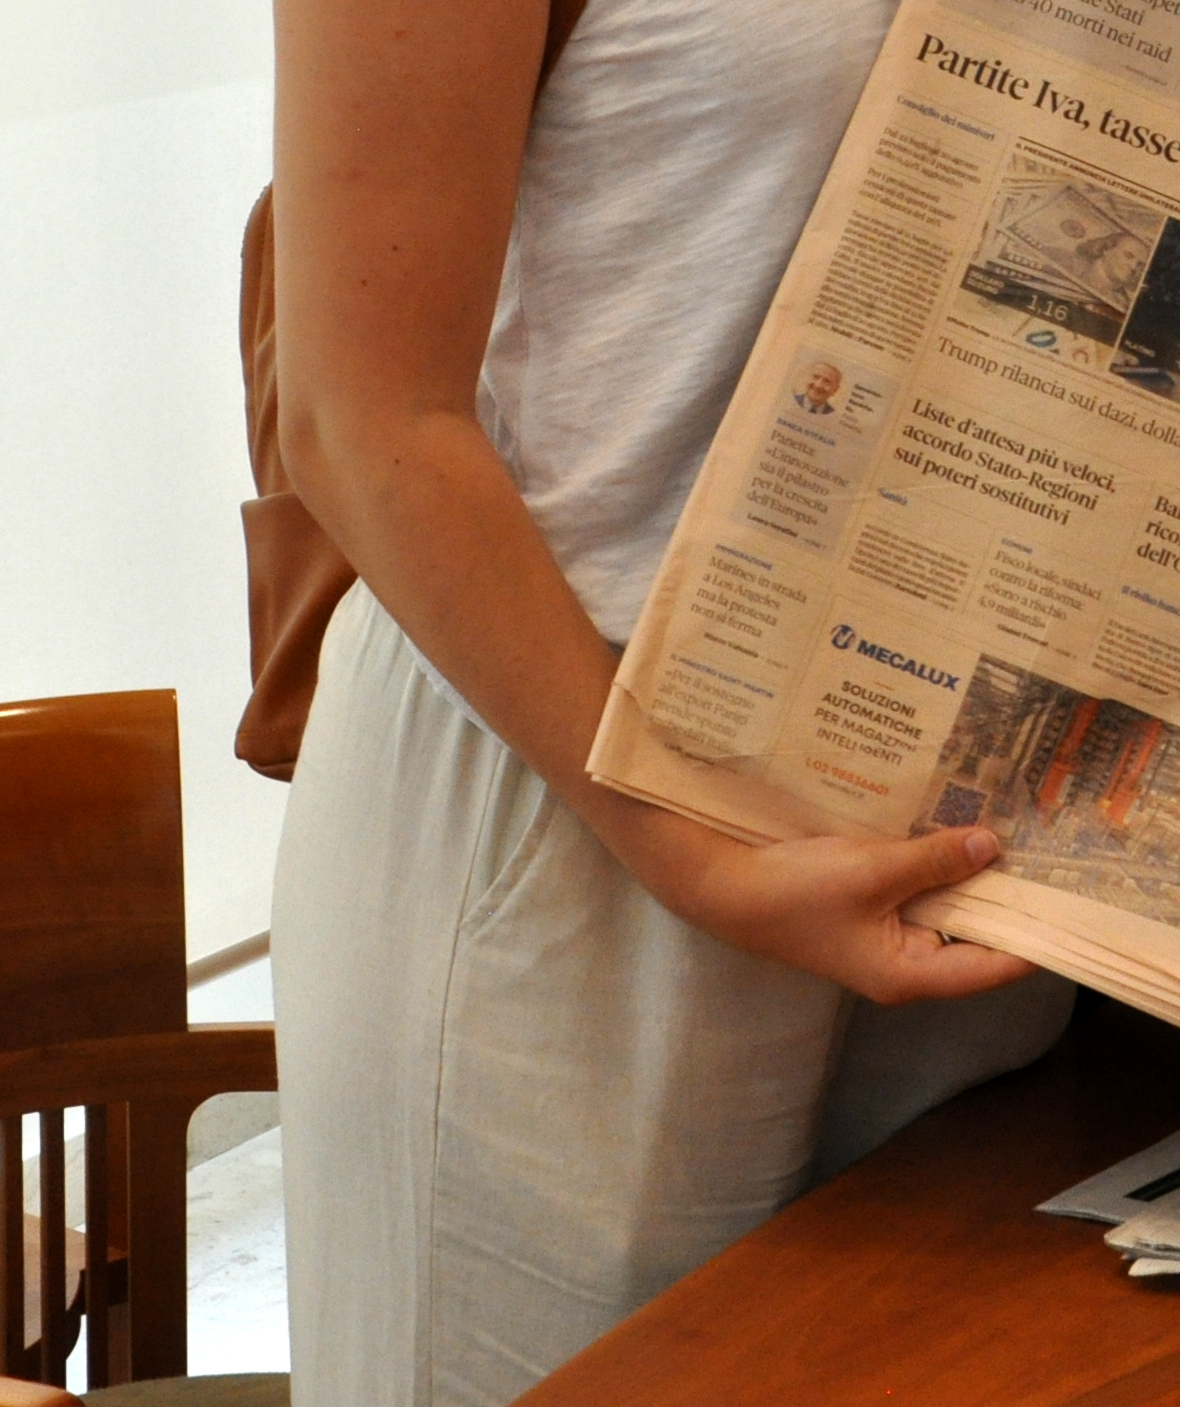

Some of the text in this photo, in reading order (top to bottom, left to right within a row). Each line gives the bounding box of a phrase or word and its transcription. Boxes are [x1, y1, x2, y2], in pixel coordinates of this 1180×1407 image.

[1054, 6, 1106, 35] morti
[1105, 27, 1136, 48] nei
[1135, 39, 1173, 63] raid
[916, 33, 1030, 100] Partite
[1032, 80, 1090, 130] Iva,
[1022, 294, 1068, 321] 1,16
[938, 336, 999, 375] Trump
[1000, 364, 1066, 401] rilancia
[1068, 392, 1098, 412] sui
[1098, 401, 1138, 431] dazi,
[902, 425, 1099, 511] accordo Stato-Regioni
[912, 398, 956, 428] Liste
[956, 418, 1026, 456] d'attesa
[1026, 448, 1059, 469] più
[1063, 460, 1116, 494] veloci,
[893, 447, 1071, 526] sui poteri sostitutivi
[856, 639, 960, 691] MECALUX
[814, 707, 840, 725] PER
[821, 692, 923, 740] AUTOMATICHE
[841, 680, 916, 719] SOLUZIONI
